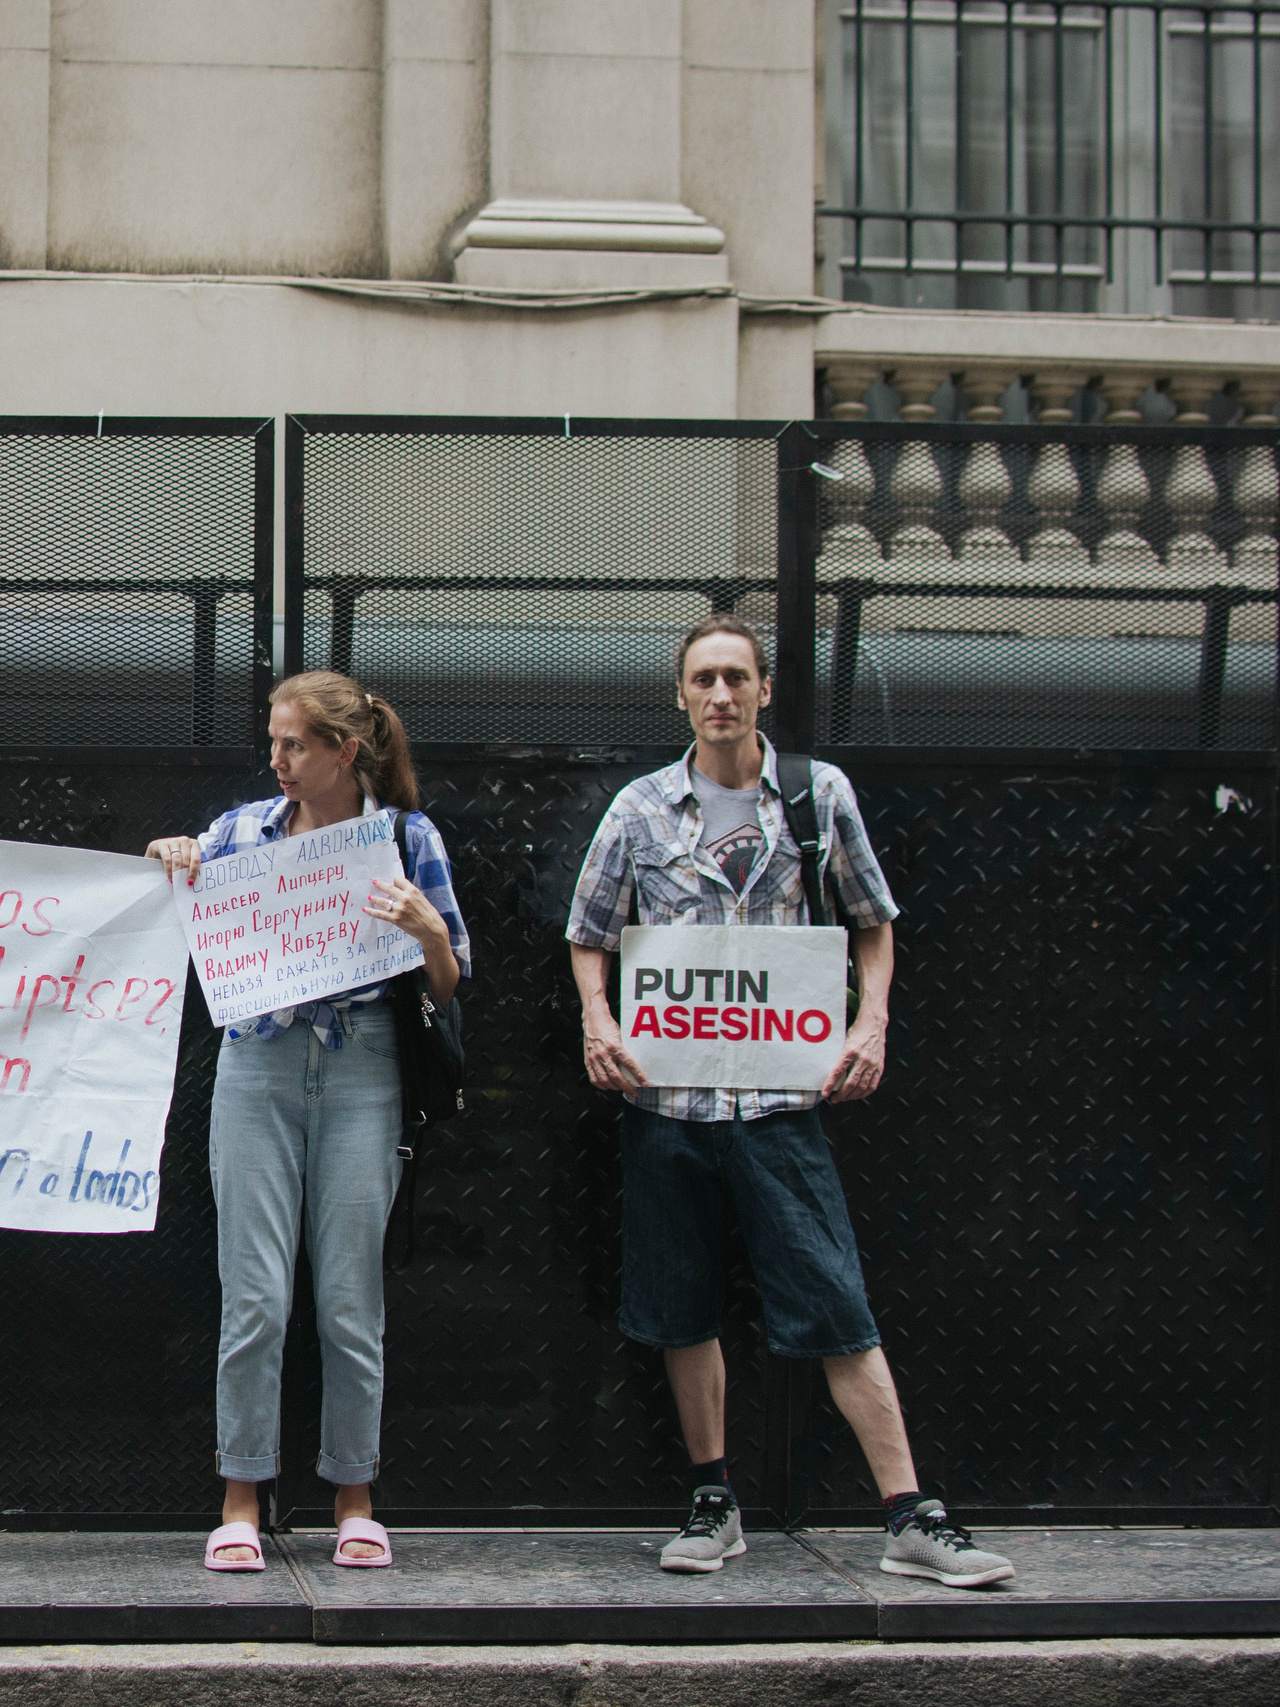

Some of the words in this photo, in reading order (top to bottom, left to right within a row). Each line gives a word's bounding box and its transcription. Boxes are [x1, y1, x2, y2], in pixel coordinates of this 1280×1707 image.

[296, 817, 394, 864] АДВОКАТАМ
[212, 974, 263, 1002] НЕЛЬЗЯ
[276, 952, 339, 982] САЖАТЬ
[346, 942, 367, 960] ЗА
[634, 967, 769, 1004] PUTIN
[630, 1005, 833, 1044] ASESINO
